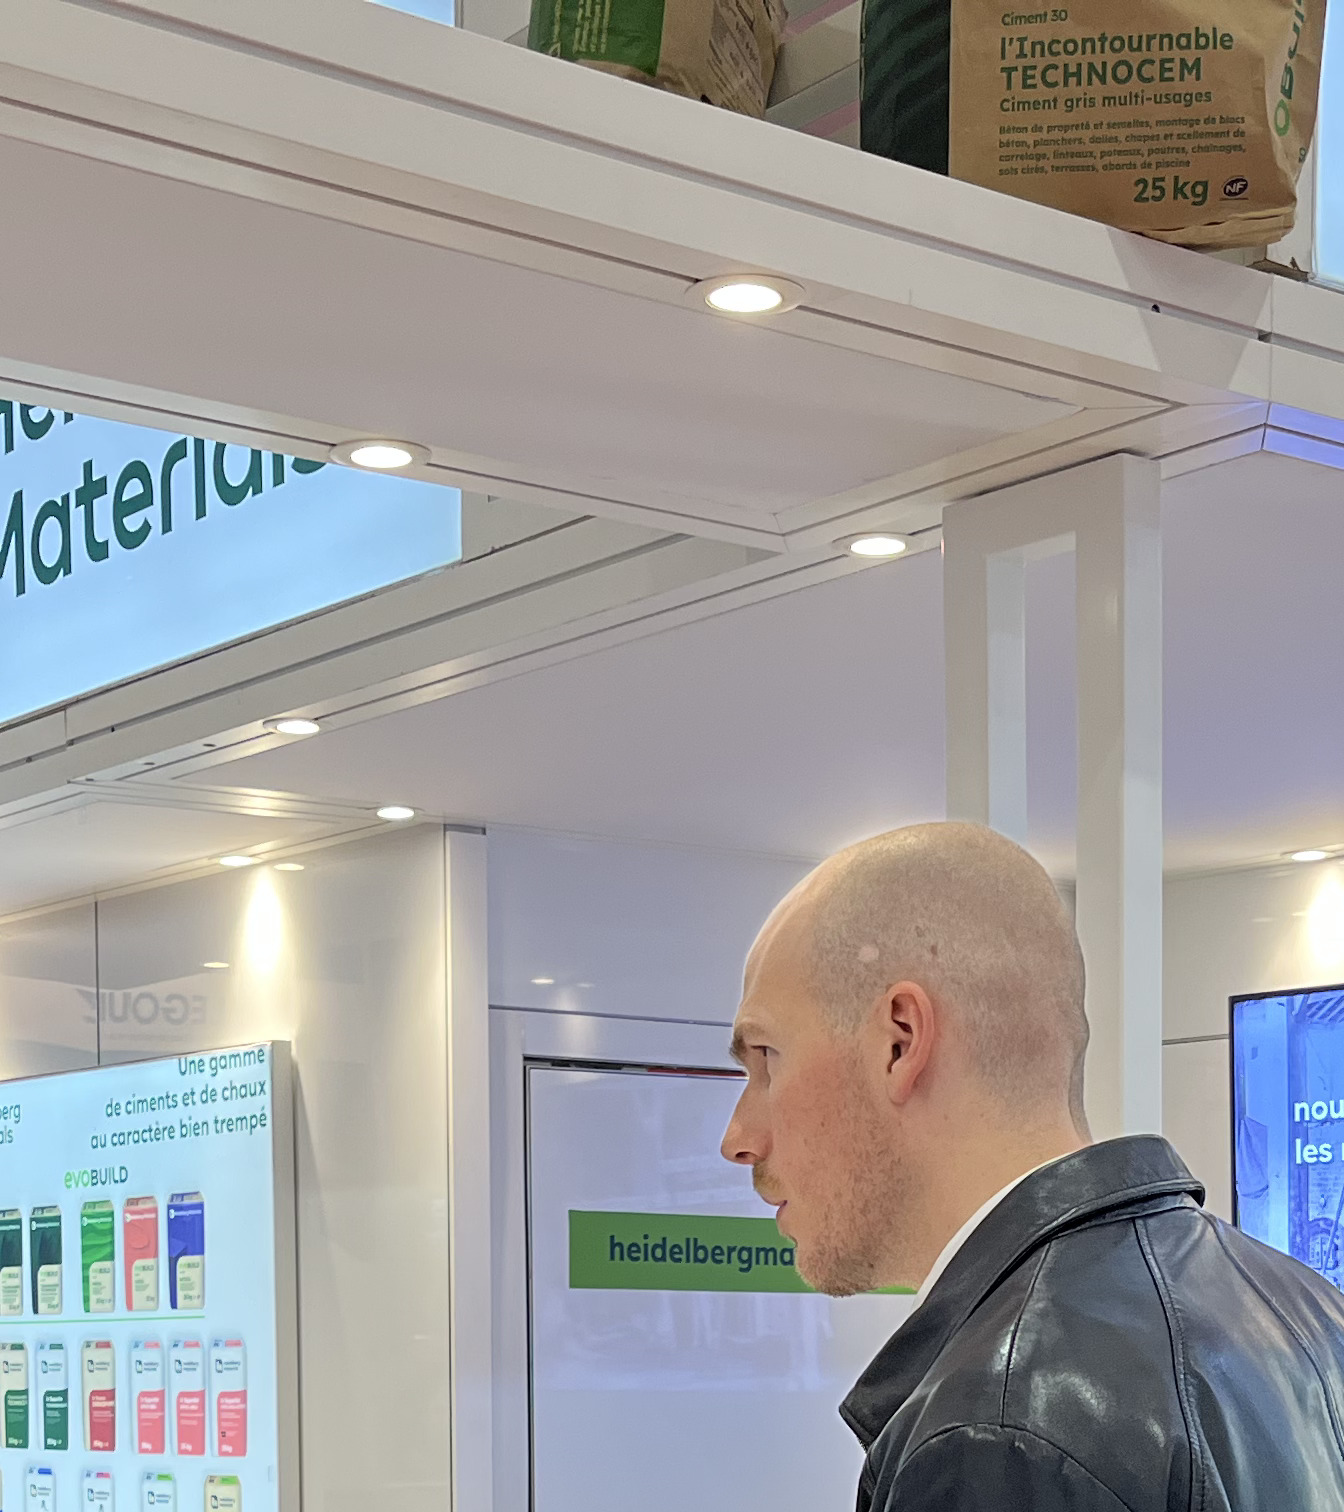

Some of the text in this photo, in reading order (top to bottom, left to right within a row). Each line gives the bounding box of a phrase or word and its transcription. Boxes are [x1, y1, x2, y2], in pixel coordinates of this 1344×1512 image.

[1001, 9, 1068, 26] Ciment 30
[1000, 27, 1234, 60] l'Incontournable
[1000, 57, 1202, 91] TECHNOCEM
[1000, 89, 1212, 114] Ciment gris multi-usages
[1133, 175, 1209, 207] 25 kg
[1225, 178, 1249, 195] NF
[178, 1047, 265, 1077] Une gamme
[105, 1078, 267, 1119] de ciments et de chaux
[91, 1105, 268, 1149] au caractère bien trempé
[1294, 1137, 1332, 1164] les
[64, 1164, 129, 1190] evoBUILD
[609, 1233, 796, 1274] heidelbergma
